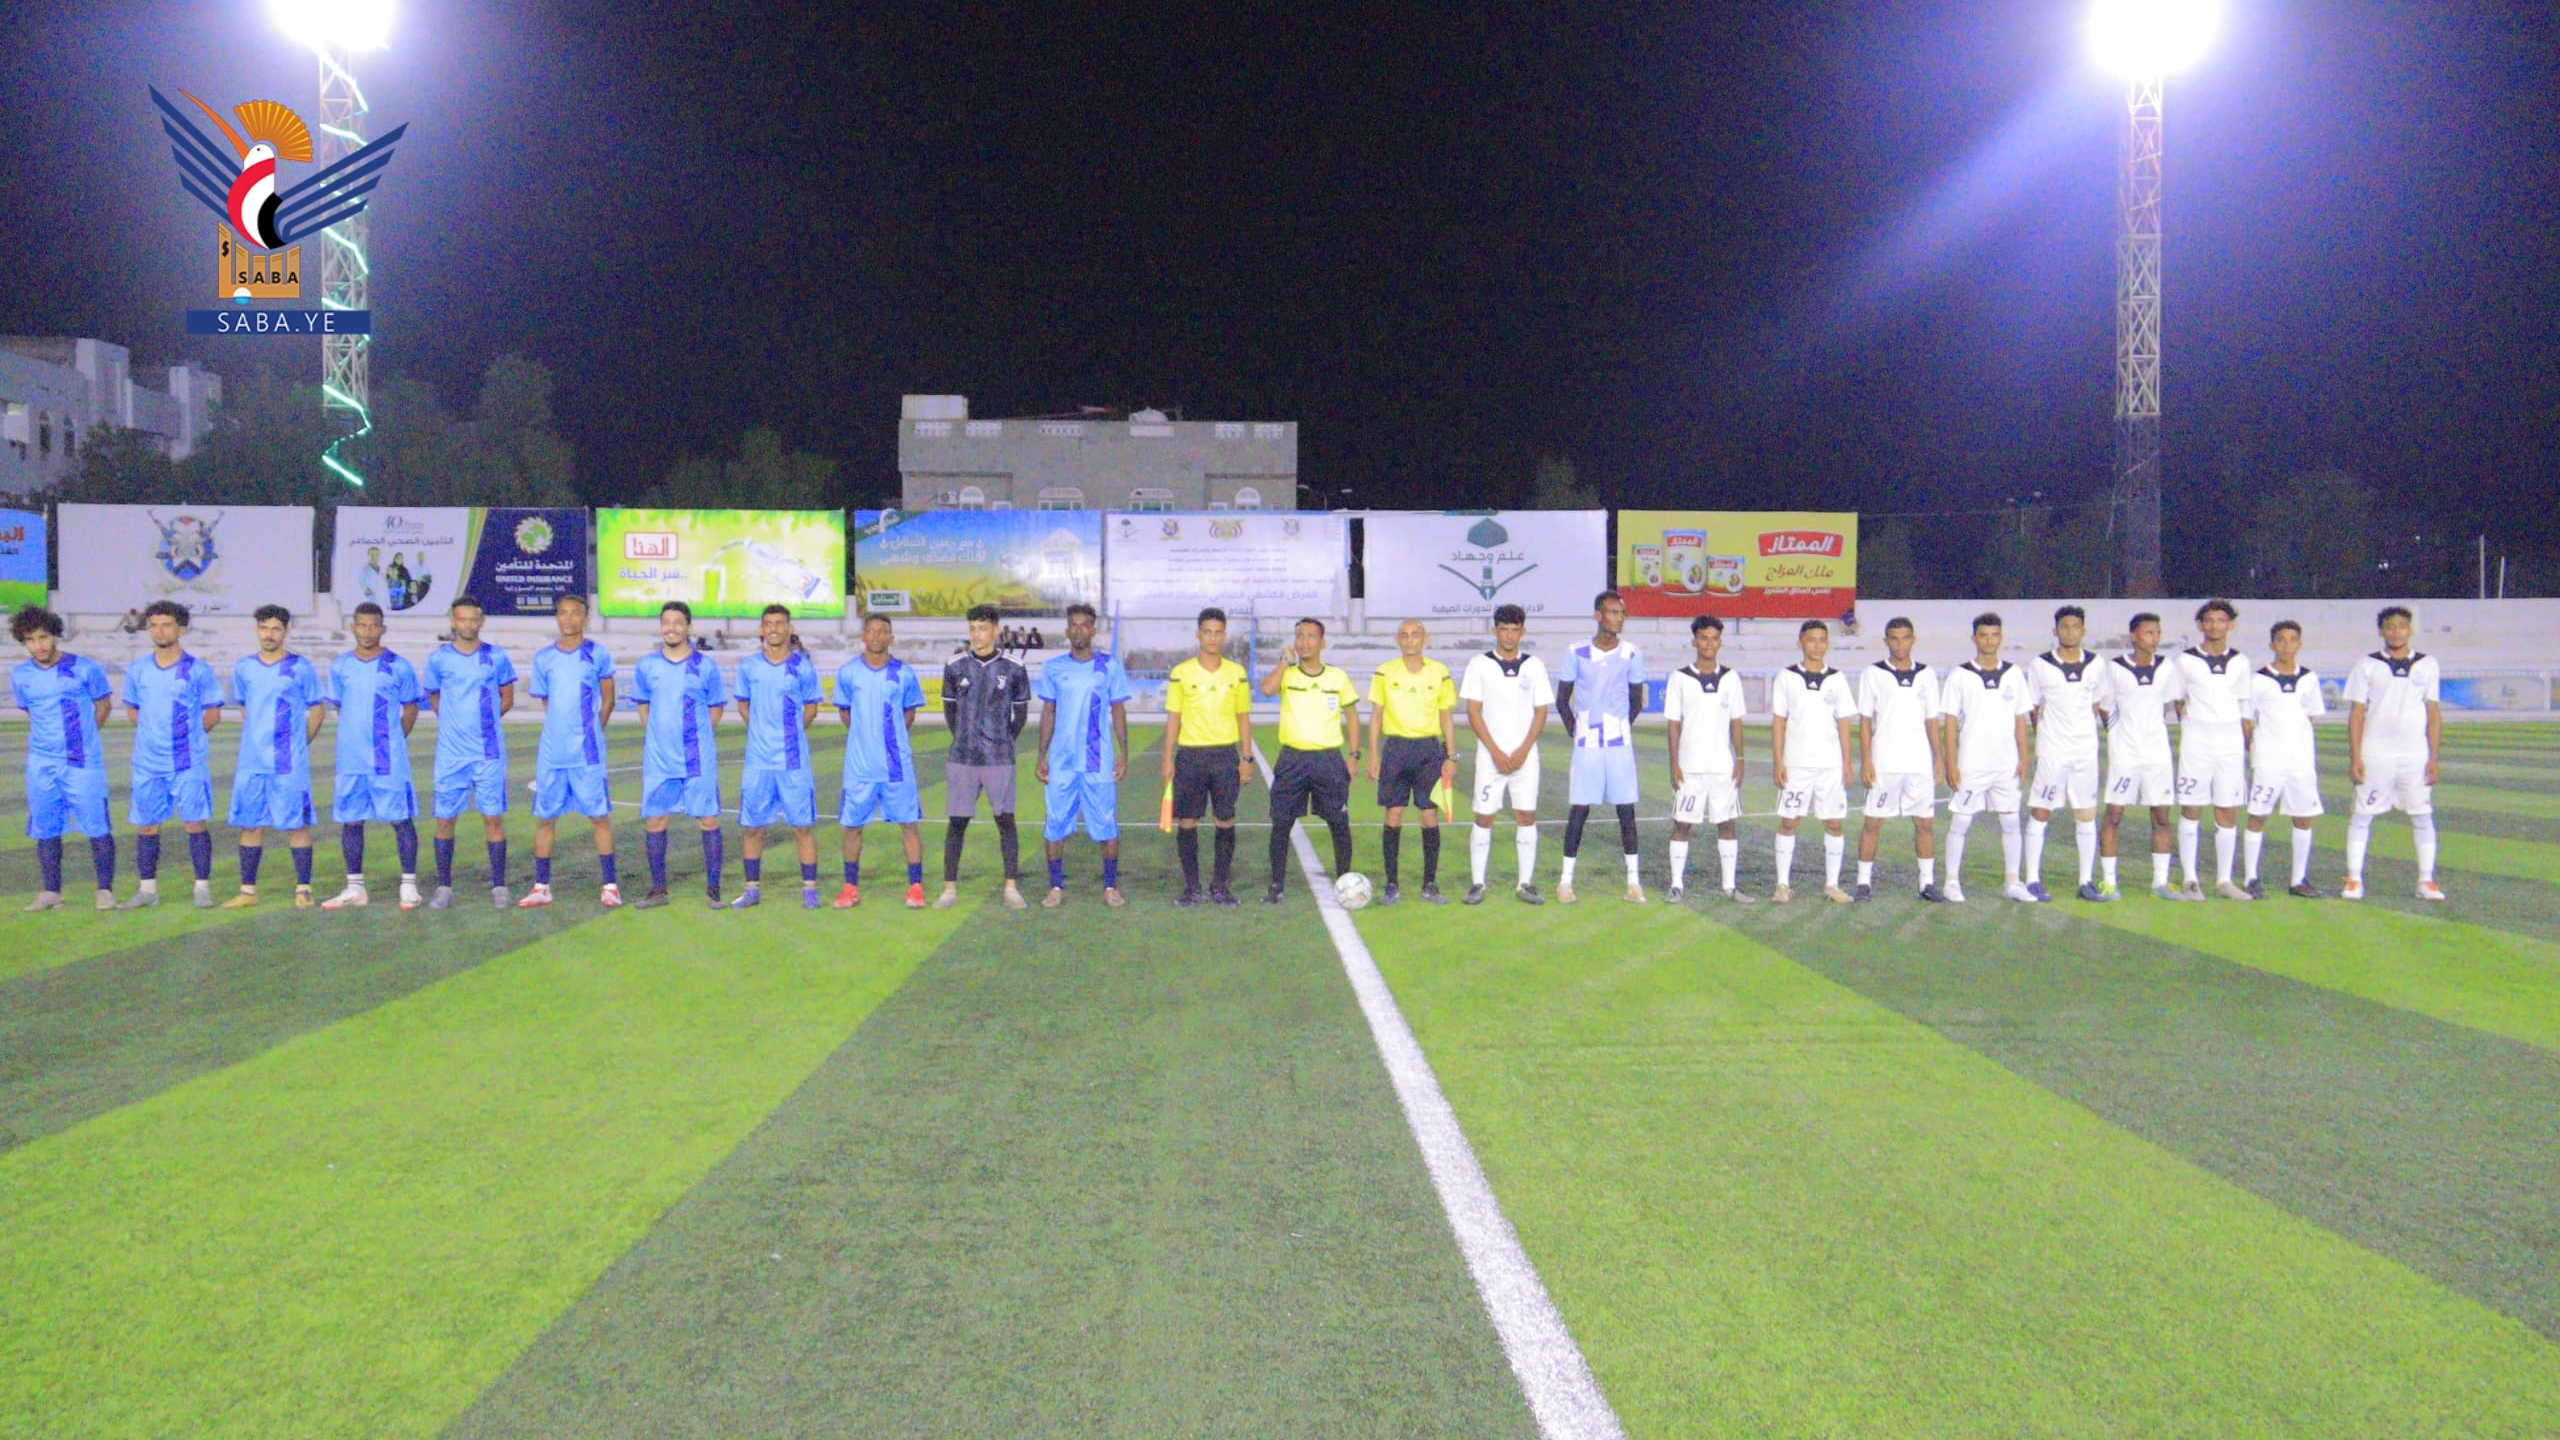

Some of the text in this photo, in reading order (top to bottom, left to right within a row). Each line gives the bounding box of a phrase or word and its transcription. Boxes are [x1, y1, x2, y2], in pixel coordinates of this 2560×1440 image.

[633, 536, 669, 556] الهنا
[1767, 534, 1834, 553] الممتاز
[1451, 550, 1525, 564] علم وجهاد
[1481, 785, 1490, 803] 5
[2112, 777, 2130, 794] 19
[2177, 777, 2197, 795] 22
[1784, 791, 1804, 808] 25
[1964, 789, 1973, 806] 7
[2253, 785, 2274, 804] 23
[1679, 795, 1696, 812] 10
